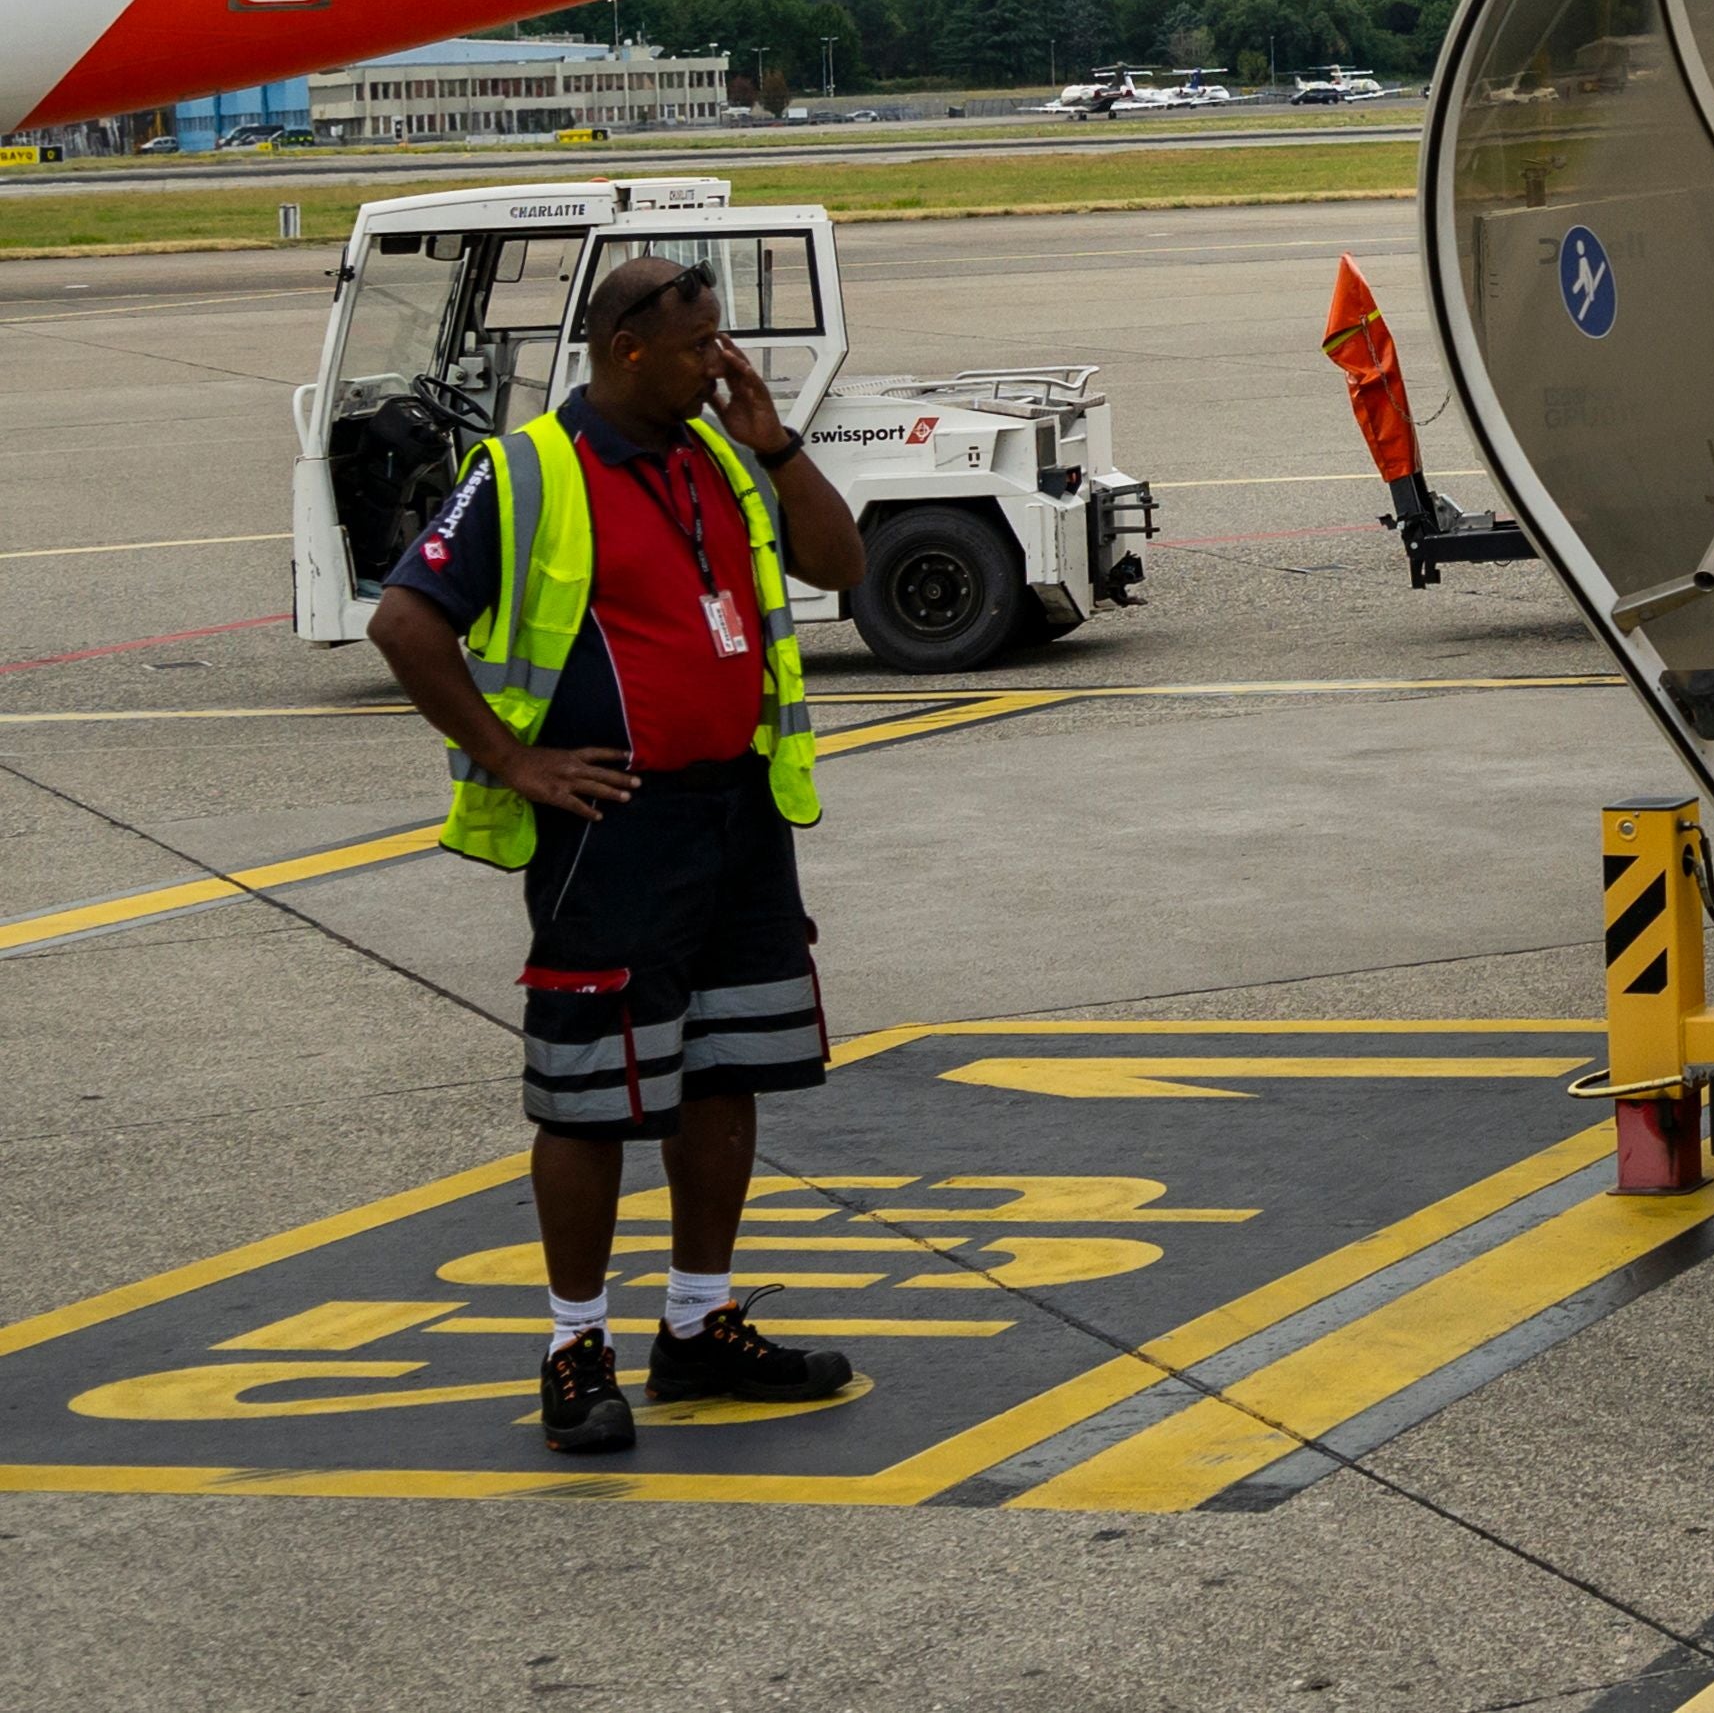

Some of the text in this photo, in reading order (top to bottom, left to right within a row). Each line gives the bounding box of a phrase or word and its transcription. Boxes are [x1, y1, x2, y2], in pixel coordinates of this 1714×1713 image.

[510, 203, 585, 218] CHARLATTE
[811, 425, 905, 445] swissport
[437, 458, 491, 538] wissport
